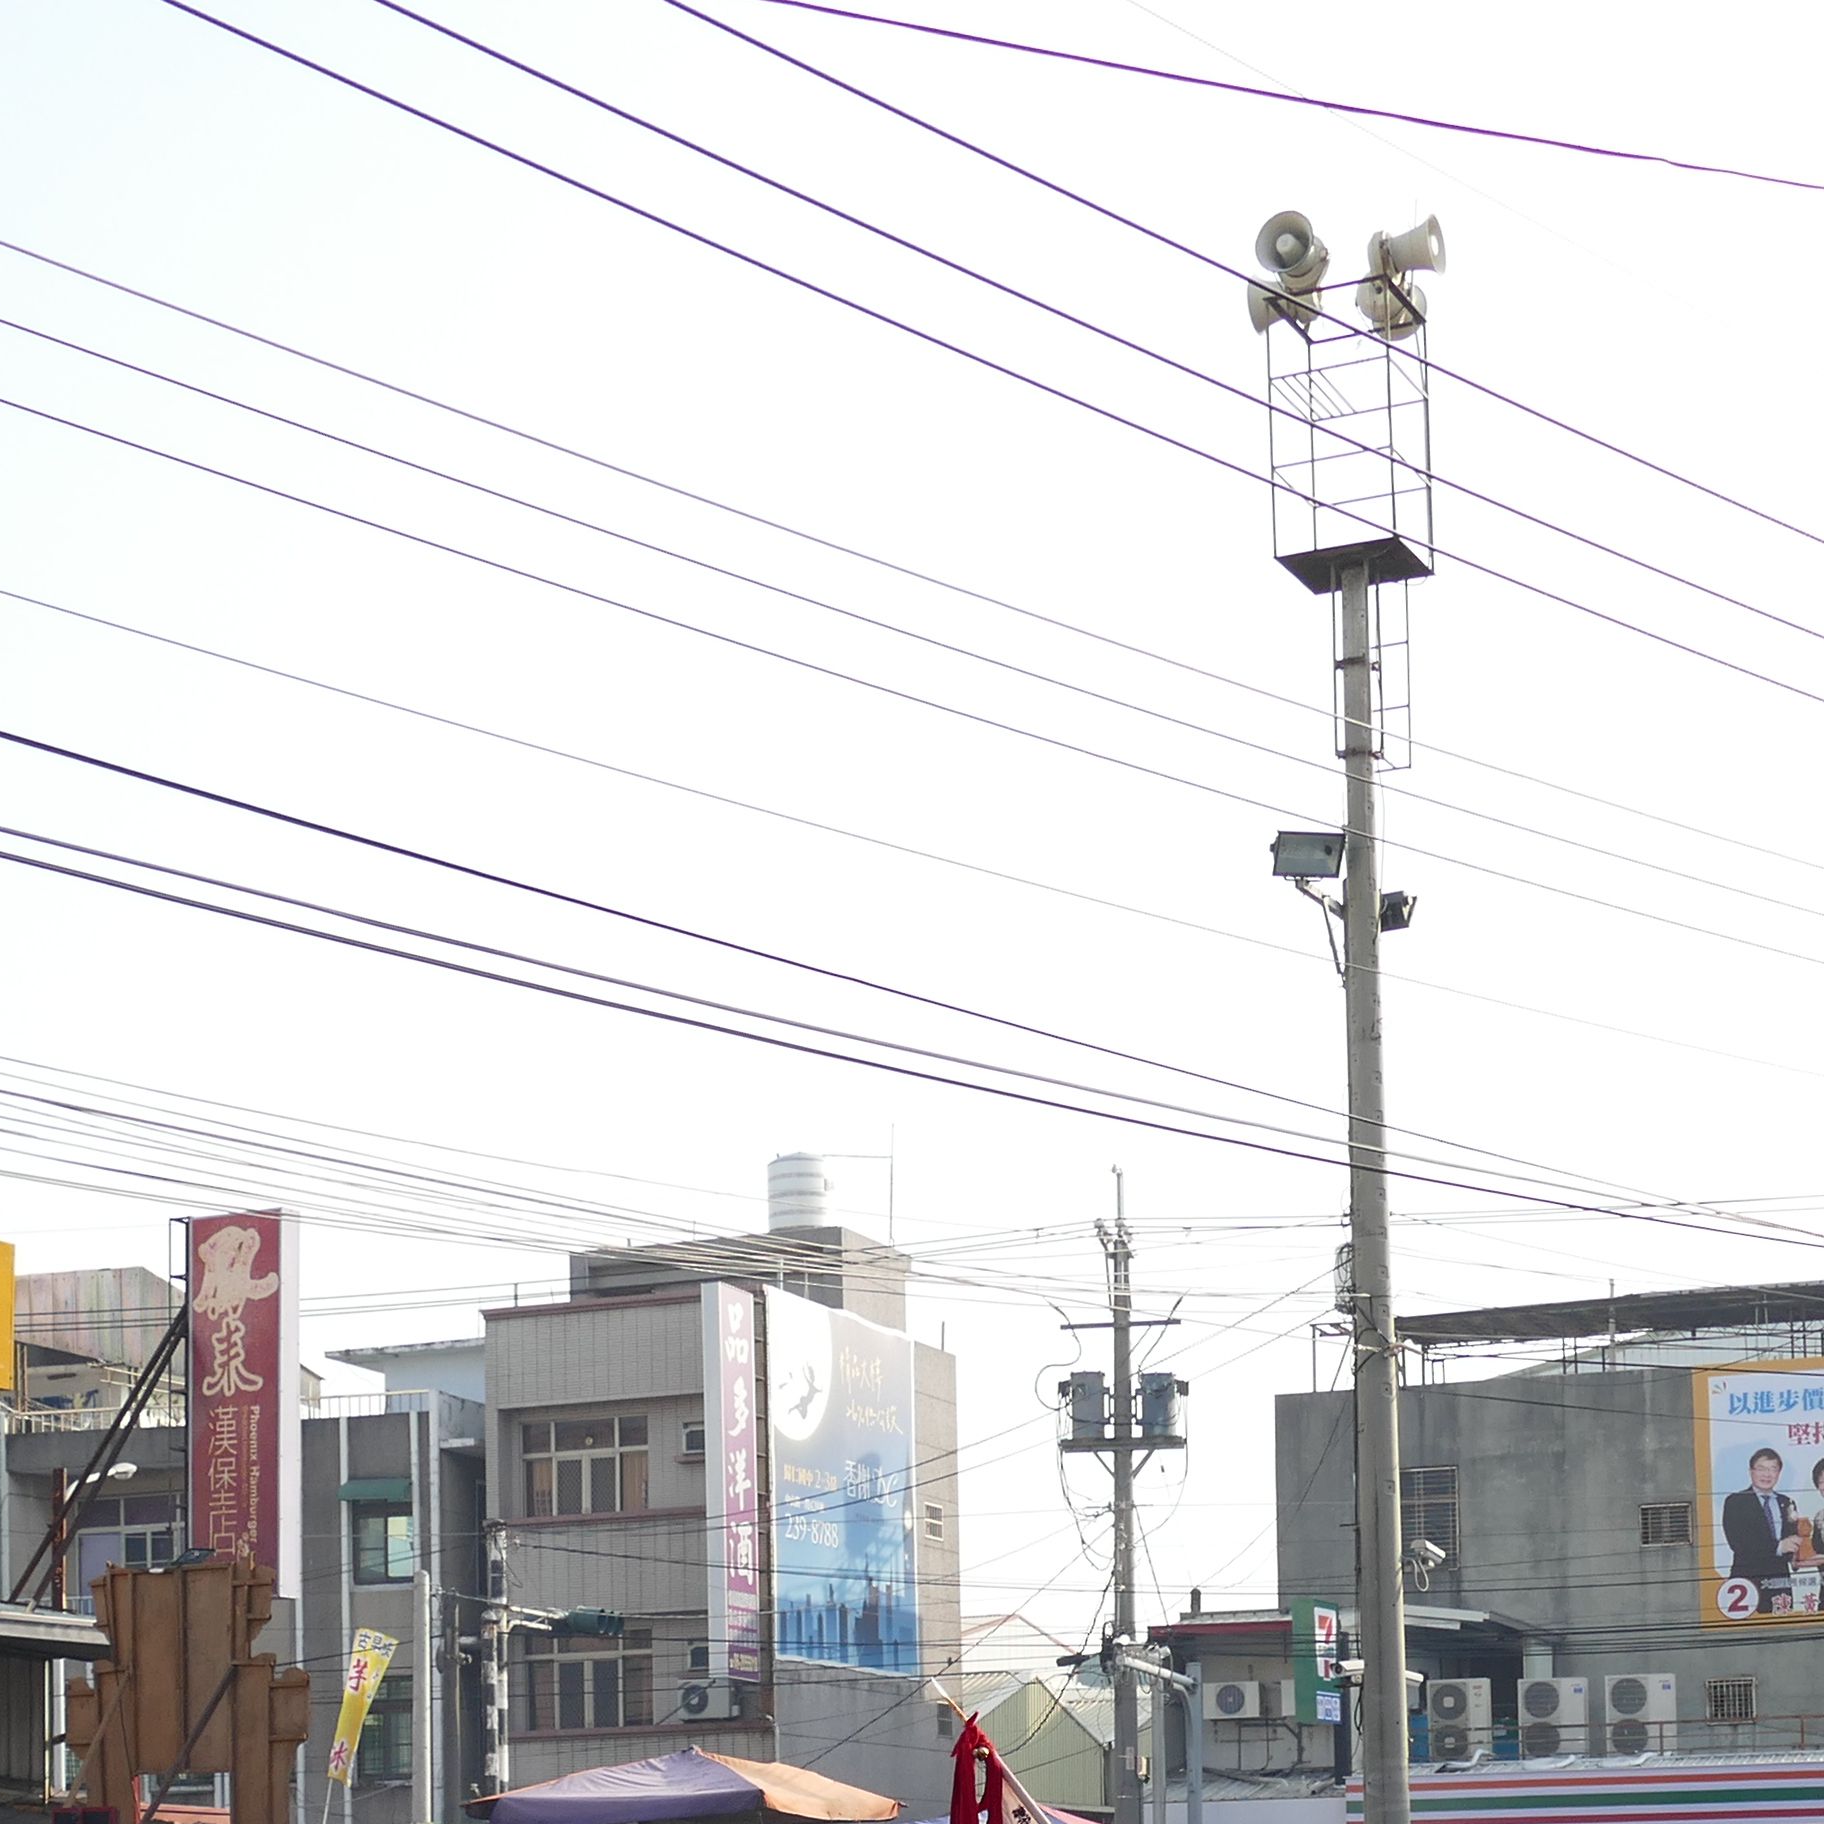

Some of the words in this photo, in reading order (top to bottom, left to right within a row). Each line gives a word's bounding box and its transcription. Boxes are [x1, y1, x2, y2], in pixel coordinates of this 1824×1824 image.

[248, 1405, 261, 1461] Phoenix
[725, 1302, 754, 1588] 品多洋酒
[1727, 1584, 1749, 1613] 2
